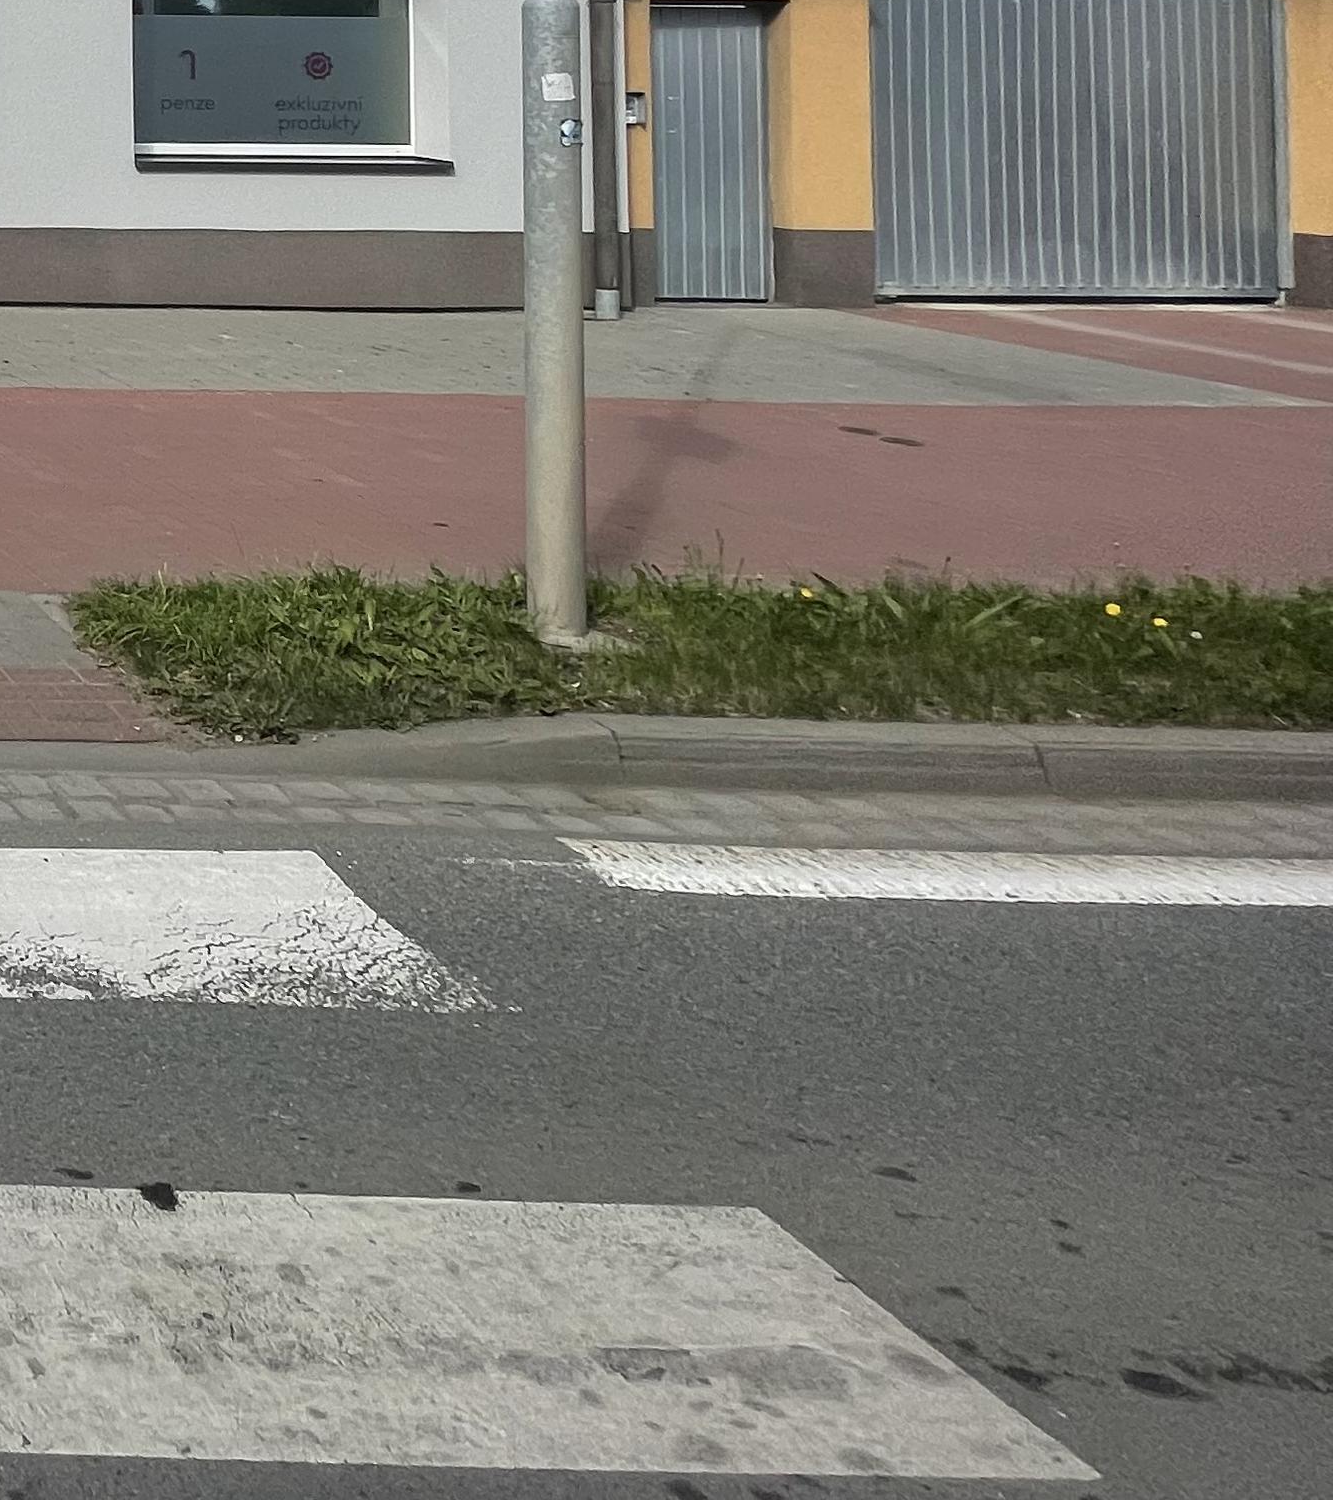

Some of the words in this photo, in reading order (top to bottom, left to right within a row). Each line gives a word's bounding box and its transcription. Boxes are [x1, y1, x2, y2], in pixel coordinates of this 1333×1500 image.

[160, 97, 216, 115] penze
[274, 95, 364, 113] exkluzivní
[277, 114, 362, 136] produkty
